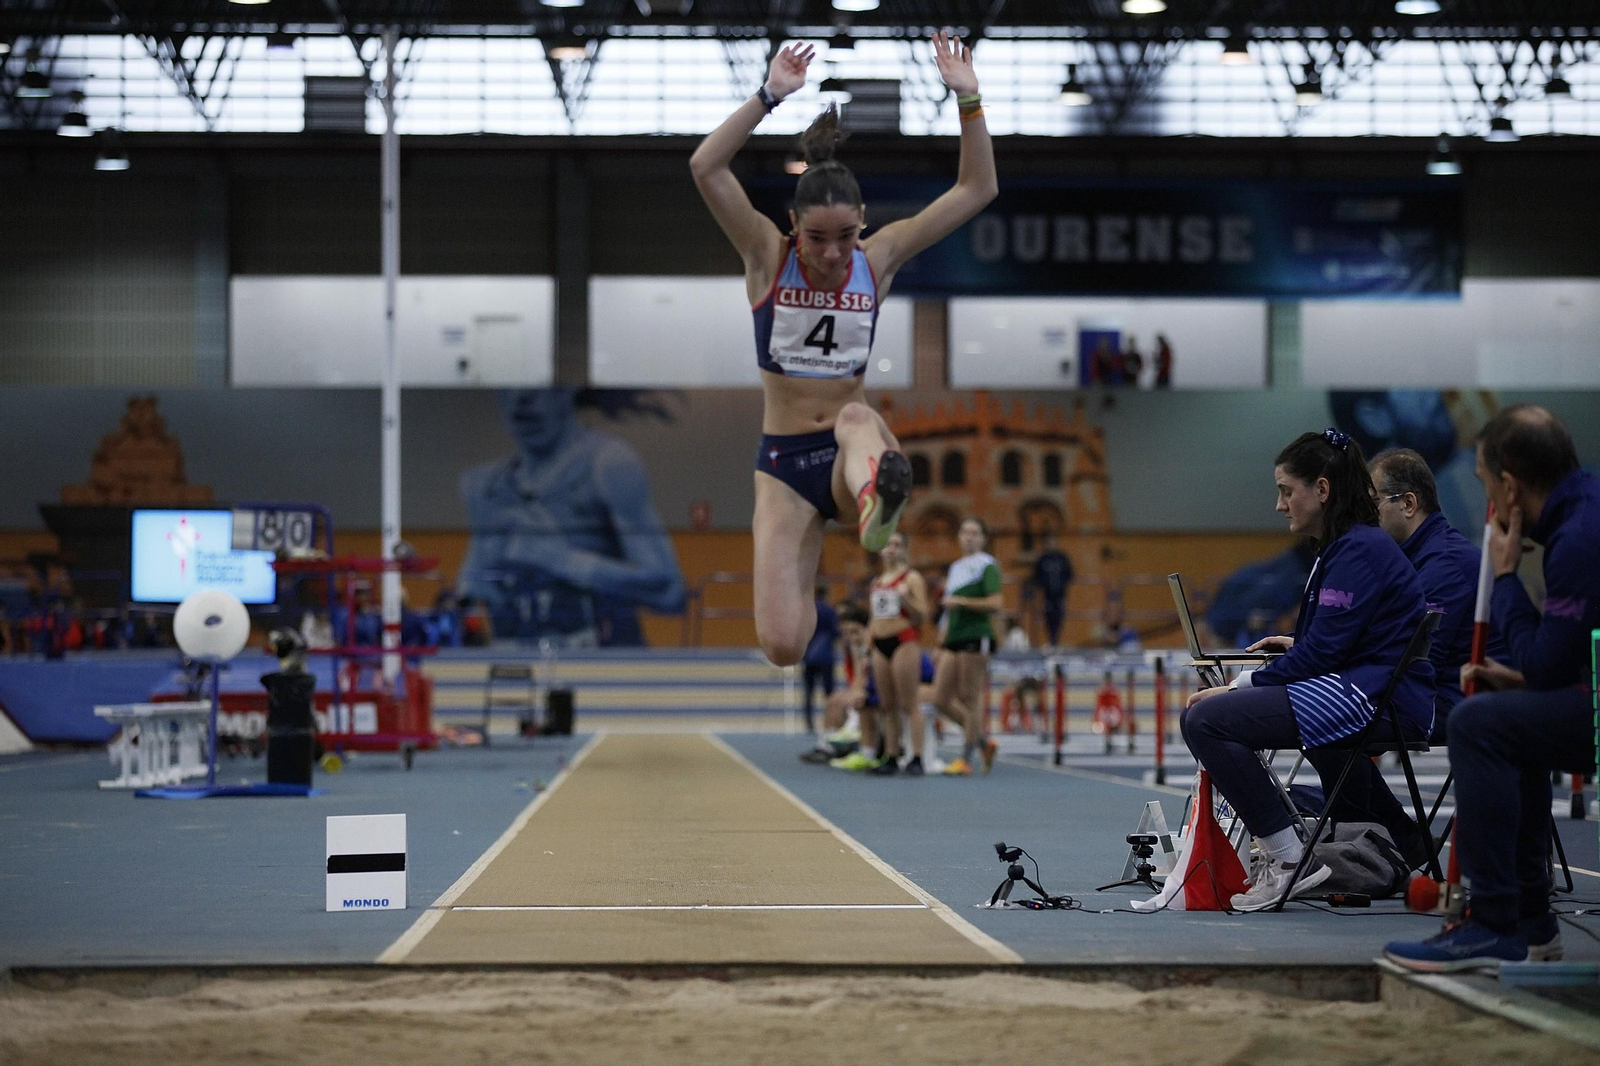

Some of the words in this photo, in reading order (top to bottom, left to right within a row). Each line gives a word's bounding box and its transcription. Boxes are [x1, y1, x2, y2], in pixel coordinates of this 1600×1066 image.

[970, 215, 1255, 264] OURENSE
[779, 288, 836, 308] CLUBS
[840, 293, 873, 311] S16
[804, 315, 838, 356] 4
[343, 899, 389, 907] MONDO
